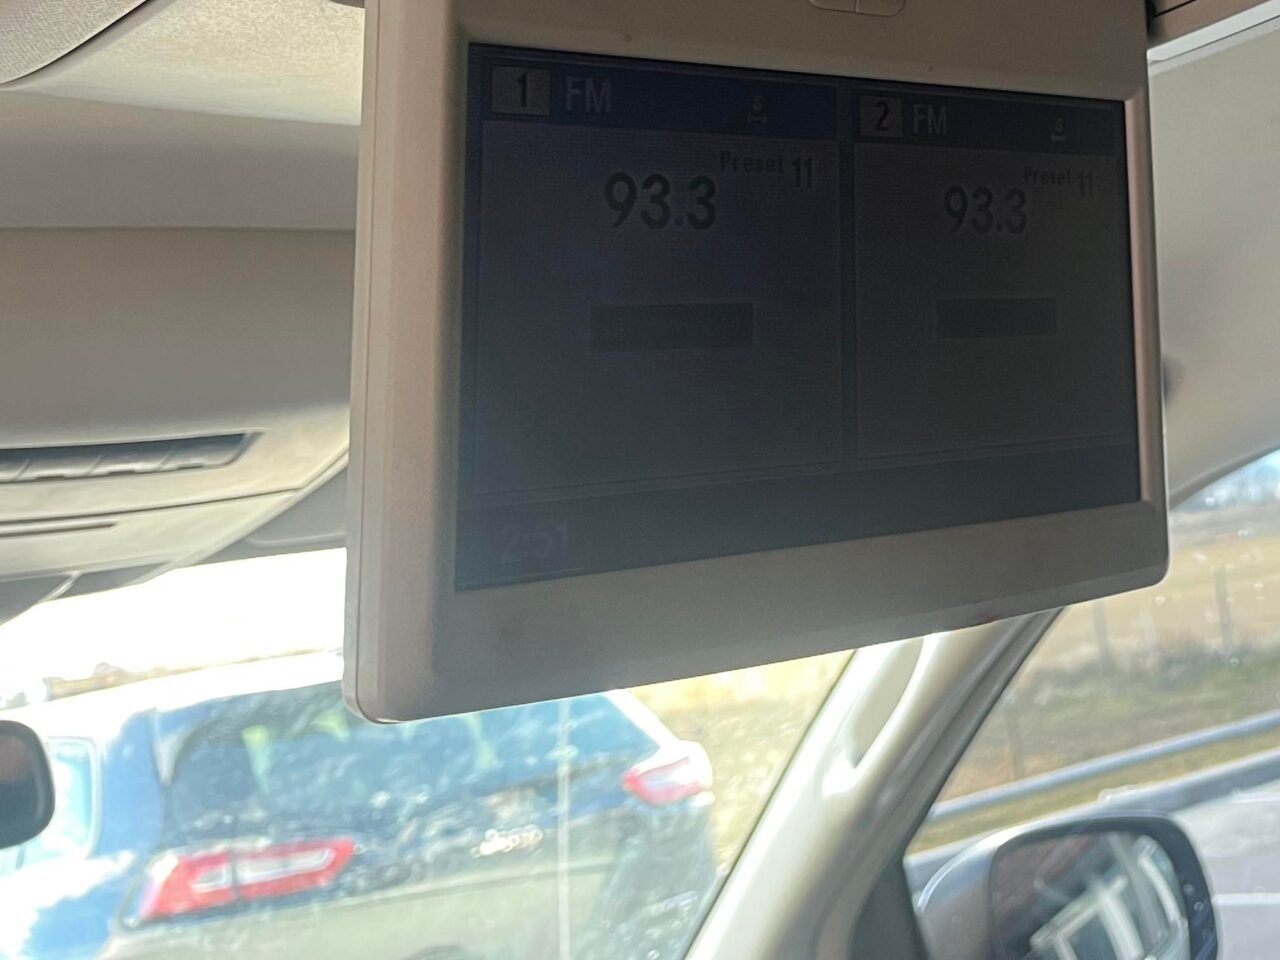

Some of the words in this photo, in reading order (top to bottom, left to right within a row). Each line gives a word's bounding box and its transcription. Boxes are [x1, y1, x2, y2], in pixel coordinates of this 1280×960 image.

[514, 72, 529, 108] 1
[565, 74, 613, 114] FM
[873, 100, 890, 132] 2
[912, 102, 949, 136] FM
[719, 150, 784, 174] Preset
[791, 155, 814, 190] 11
[1023, 164, 1072, 186] Preset
[1077, 169, 1096, 198] 11
[604, 171, 717, 231] 93.3
[944, 185, 1027, 235] 93.3
